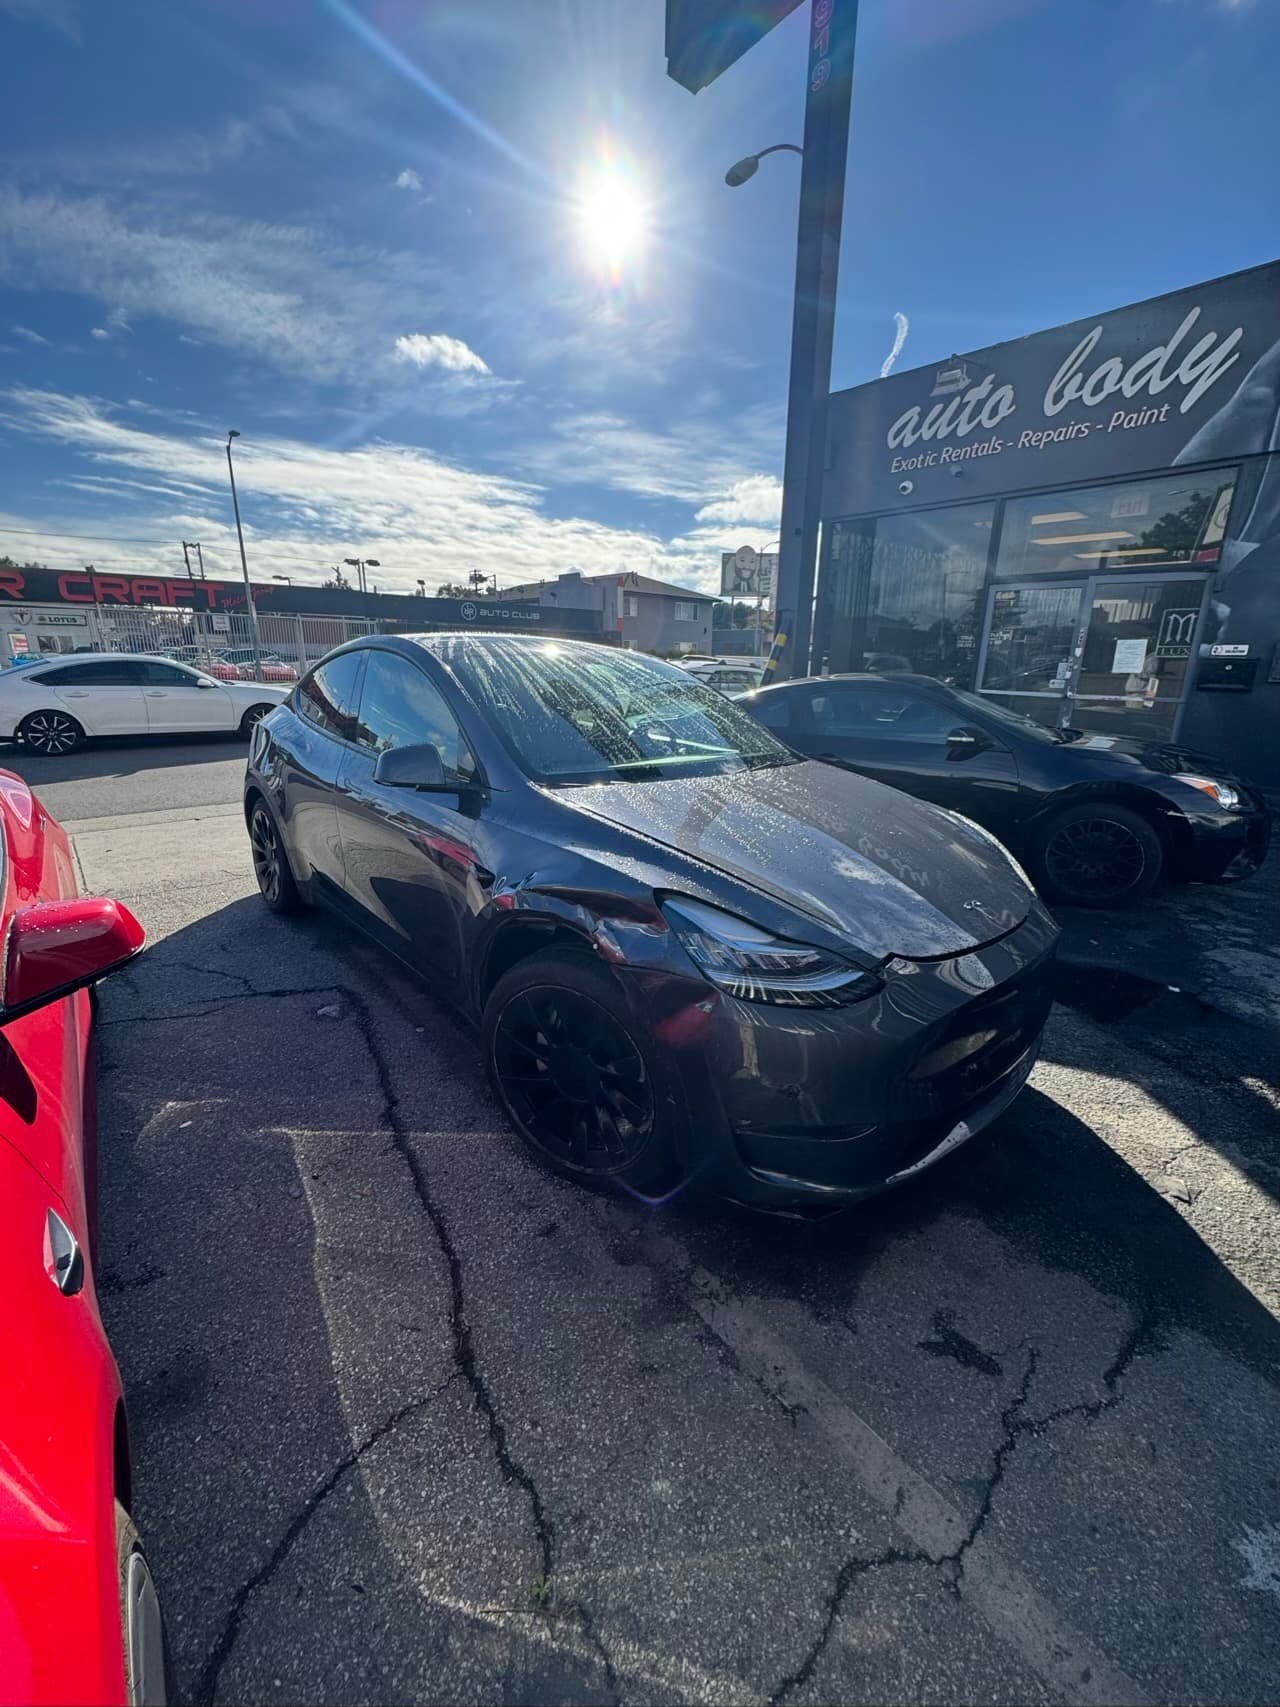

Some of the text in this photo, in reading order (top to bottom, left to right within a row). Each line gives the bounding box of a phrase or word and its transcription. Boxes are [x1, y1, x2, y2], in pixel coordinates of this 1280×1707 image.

[887, 306, 1243, 449] auto body
[890, 450, 937, 474] Exotic
[940, 435, 1003, 465] Rentals
[1018, 419, 1089, 451] Repairs
[1108, 402, 1171, 433] Paint
[57, 573, 225, 608] CRAFT
[48, 616, 77, 624] LOTUS
[480, 608, 510, 618] AUTO
[511, 610, 541, 620] CLUB
